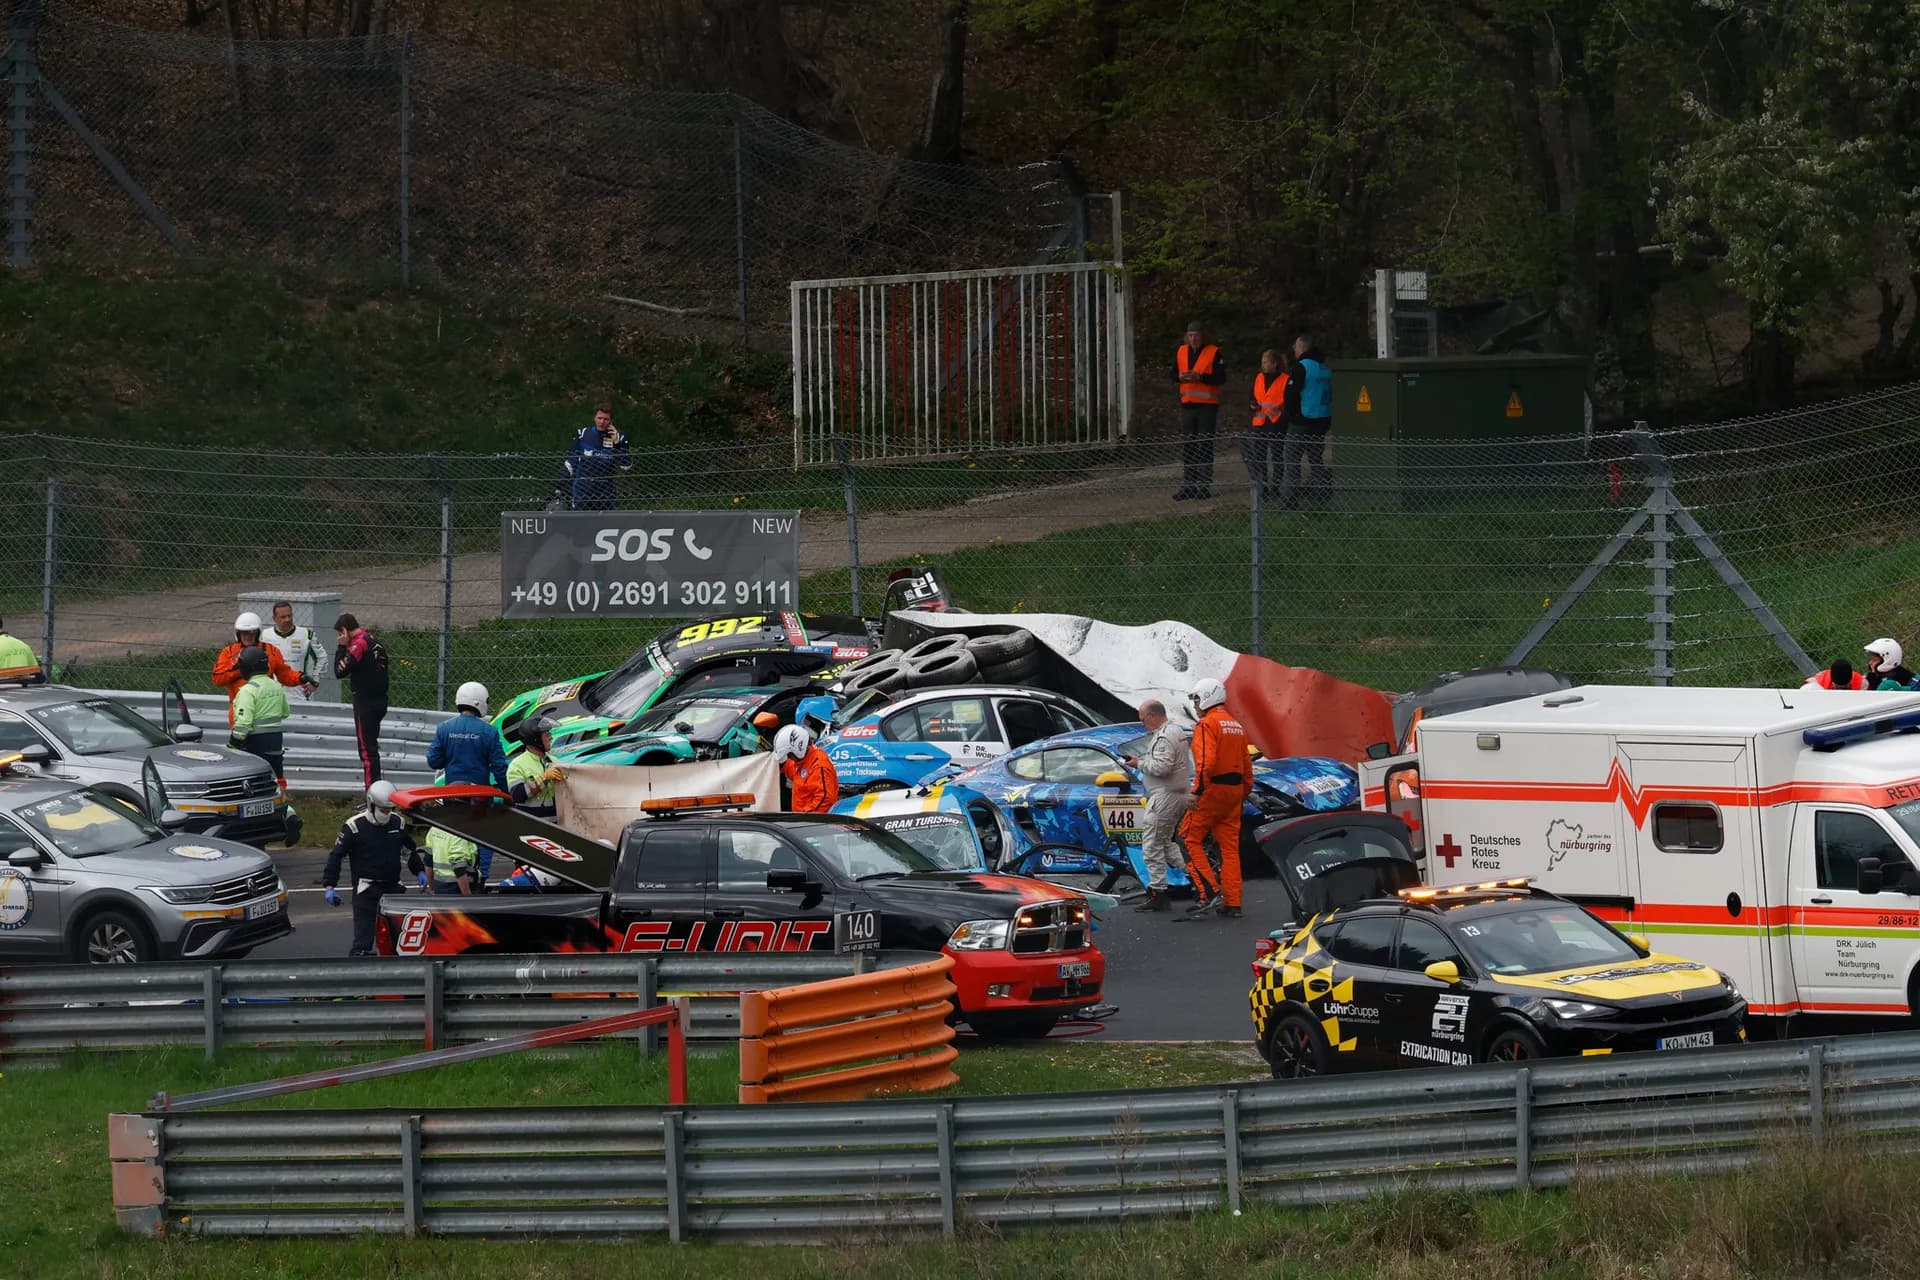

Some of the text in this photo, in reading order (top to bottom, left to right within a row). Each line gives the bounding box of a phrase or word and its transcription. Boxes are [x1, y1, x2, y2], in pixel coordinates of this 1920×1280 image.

[511, 518, 793, 534] NEU NEW
[590, 528, 675, 561] SOS
[510, 580, 791, 611] +49 (0) 2691 302 9111
[676, 615, 767, 648] 992
[884, 819, 915, 831] GRAN
[1108, 810, 1135, 829] 448
[1125, 832, 1144, 841] DEK
[1470, 834, 1521, 846] Deutsches
[1471, 846, 1499, 858] Rotes
[1560, 840, 1612, 853] nürburgring
[1472, 858, 1501, 870] Kreuz
[847, 912, 875, 939] 140
[1877, 915, 1919, 926] 29/86-12
[396, 910, 433, 956] 8
[1460, 925, 1481, 938] 13
[1836, 939, 1877, 949] DRK Jülich
[1837, 950, 1856, 958] Team
[1838, 959, 1880, 971] Nürburgring
[1324, 1002, 1379, 1019] LöhrGruppe
[1665, 1038, 1679, 1050] KO
[1400, 1040, 1451, 1065] EXTRICATION
[1451, 1051, 1468, 1066] CAR
